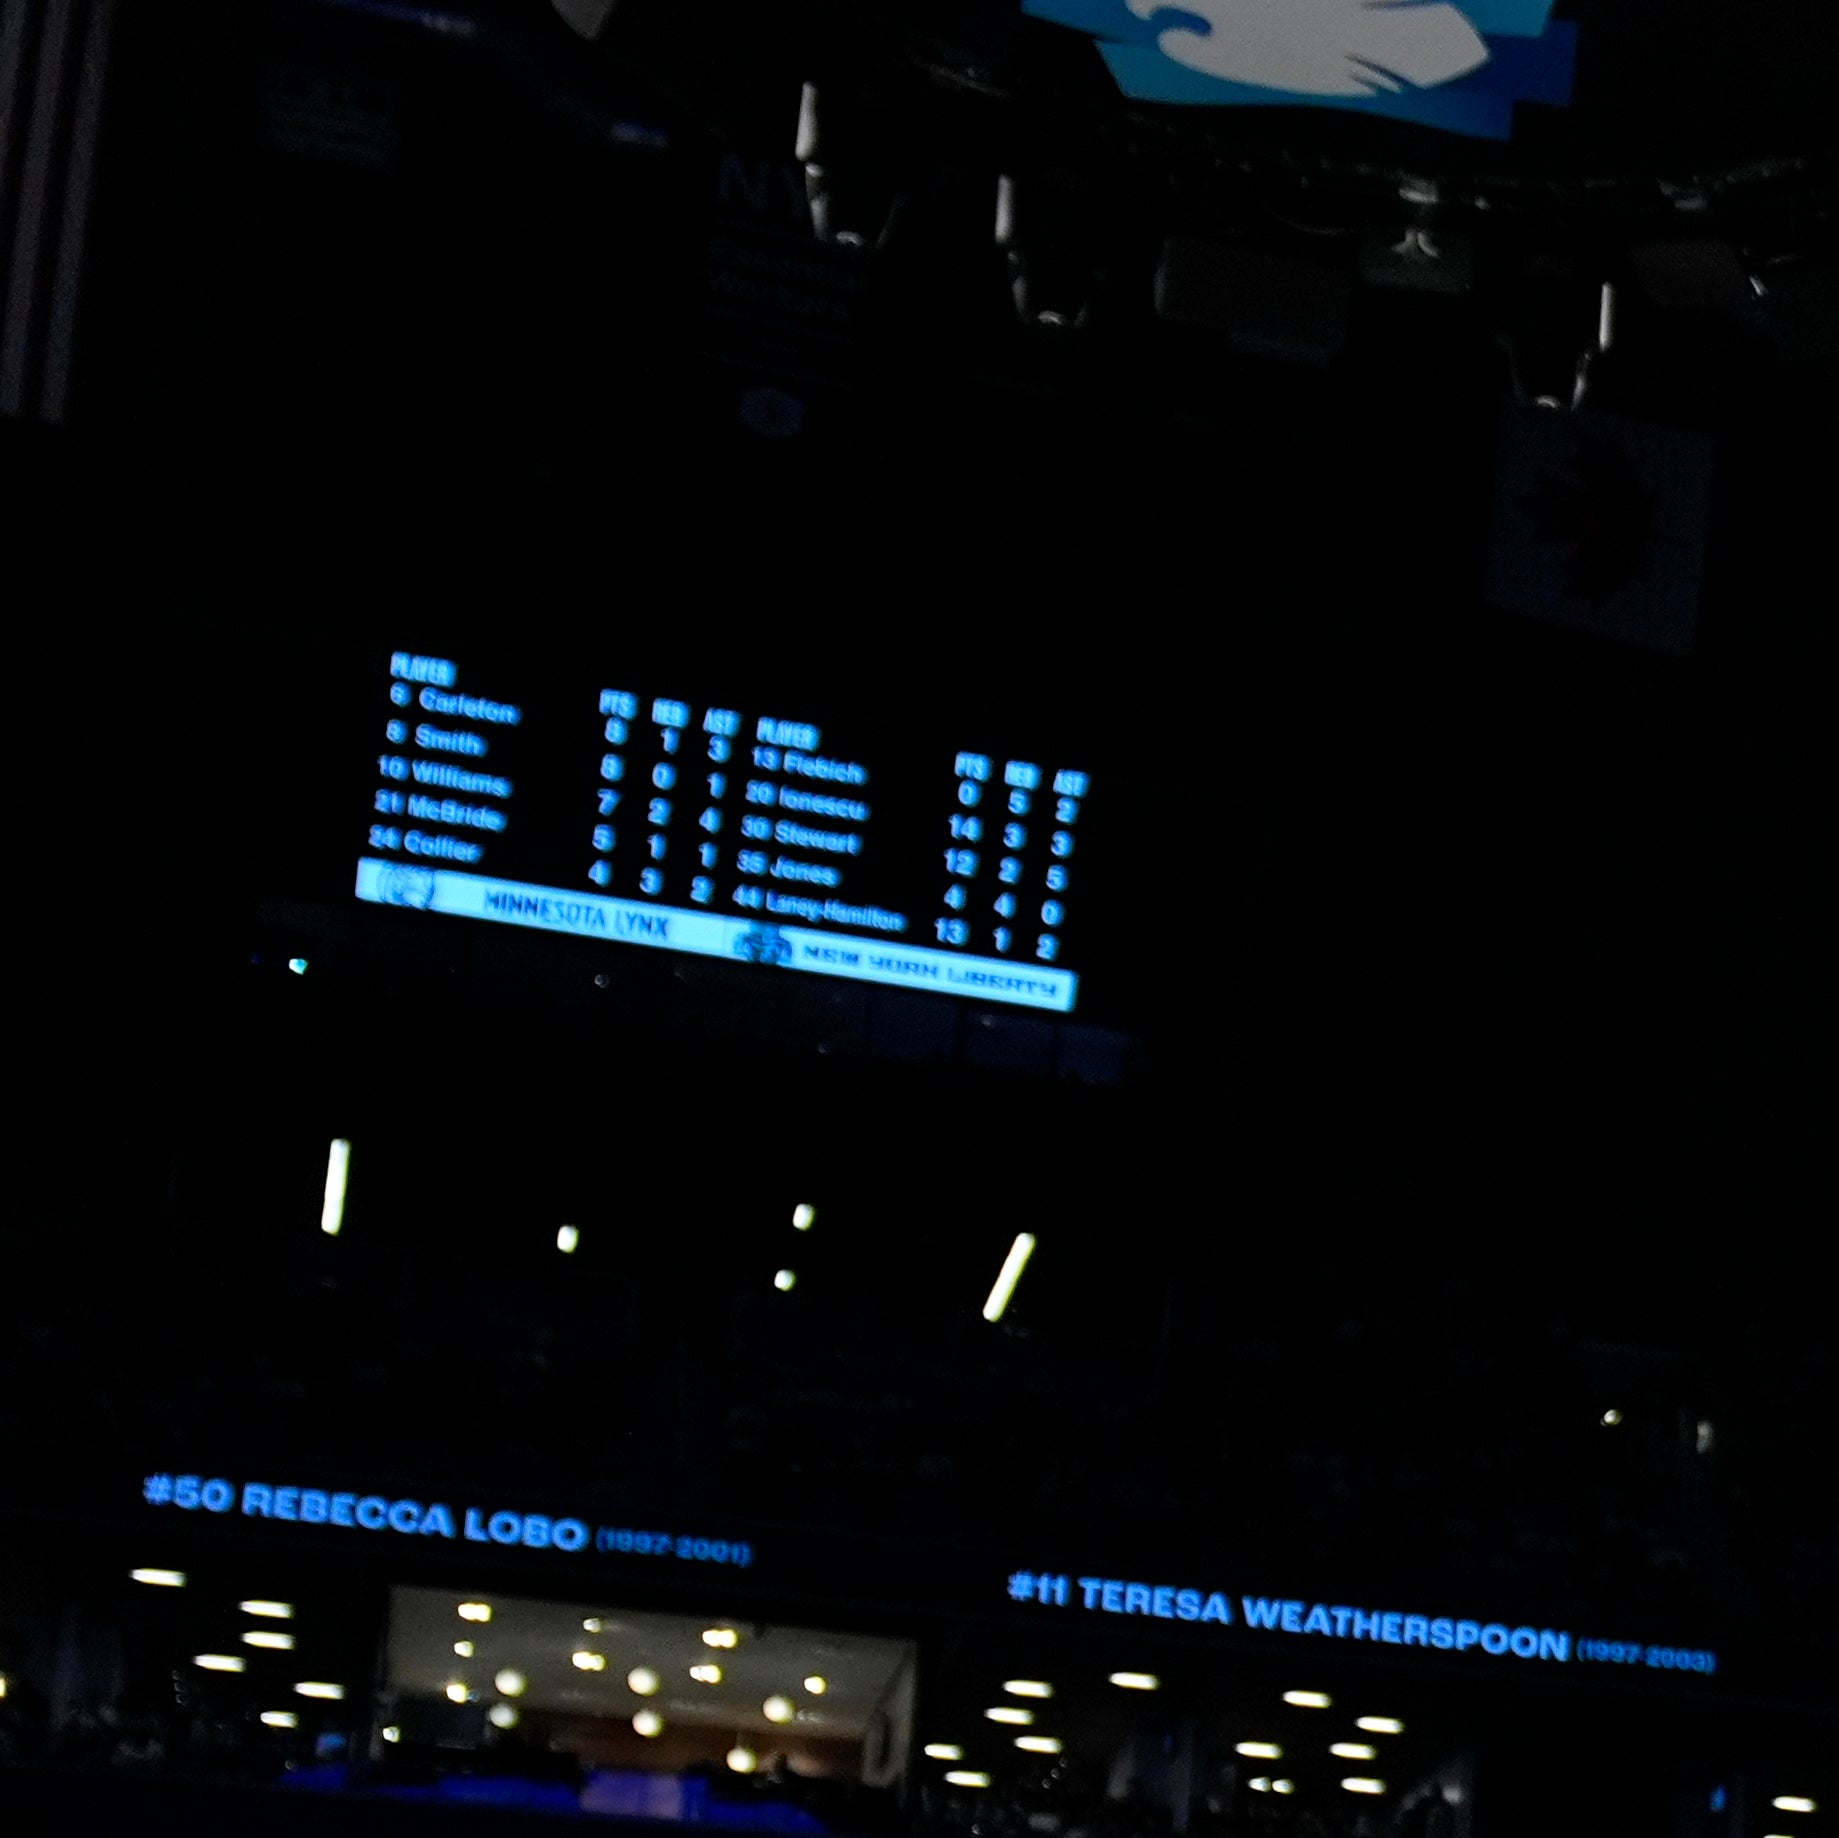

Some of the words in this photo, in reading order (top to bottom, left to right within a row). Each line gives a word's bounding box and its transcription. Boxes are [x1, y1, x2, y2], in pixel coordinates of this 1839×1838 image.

[414, 723, 489, 758] Smith
[652, 762, 679, 791] 0
[706, 771, 727, 800] 1
[418, 686, 523, 726] Carleton
[661, 726, 680, 755] 1
[707, 734, 732, 763] 3
[378, 754, 411, 781] 10
[411, 759, 514, 799] Williams
[597, 787, 623, 817] 7
[648, 797, 673, 826] 2
[698, 806, 723, 834] 4
[745, 779, 780, 807] 20
[948, 813, 984, 844] 14
[1002, 822, 1028, 851] 3
[1050, 830, 1076, 860] 3
[751, 746, 784, 773] 13
[957, 778, 983, 808] 0
[1007, 788, 1033, 817] 5
[1055, 797, 1081, 826] 2
[403, 829, 485, 865] Collier
[588, 858, 613, 888] 4
[639, 866, 665, 896] 3
[407, 793, 508, 833] McBride
[592, 823, 618, 853] 5
[647, 832, 669, 861] 1
[698, 841, 719, 870] 1
[740, 814, 775, 841] 30
[774, 818, 864, 857] Stewart
[943, 847, 981, 879] 12
[998, 855, 1024, 886] 2
[1045, 864, 1071, 893] 5
[484, 889, 606, 931] MINNESOTA
[613, 908, 670, 938] LYNX
[736, 848, 771, 876] 35
[770, 855, 844, 888] Jones
[943, 883, 968, 913] 4
[993, 891, 1018, 920] 4
[1040, 899, 1065, 928] 0
[803, 942, 859, 968] NEW
[869, 953, 940, 982] YORK
[946, 965, 1058, 998] LIBERTY
[934, 917, 971, 948] 13
[993, 926, 1014, 954] 1
[1035, 933, 1061, 962] 2
[142, 1472, 237, 1513] #50
[240, 1481, 457, 1539] REBECCA
[463, 1506, 582, 1552] LOBO
[1006, 1569, 1071, 1608] #11
[1077, 1575, 1235, 1626] TERESA
[1241, 1594, 1572, 1663] WEATHERSPOON
